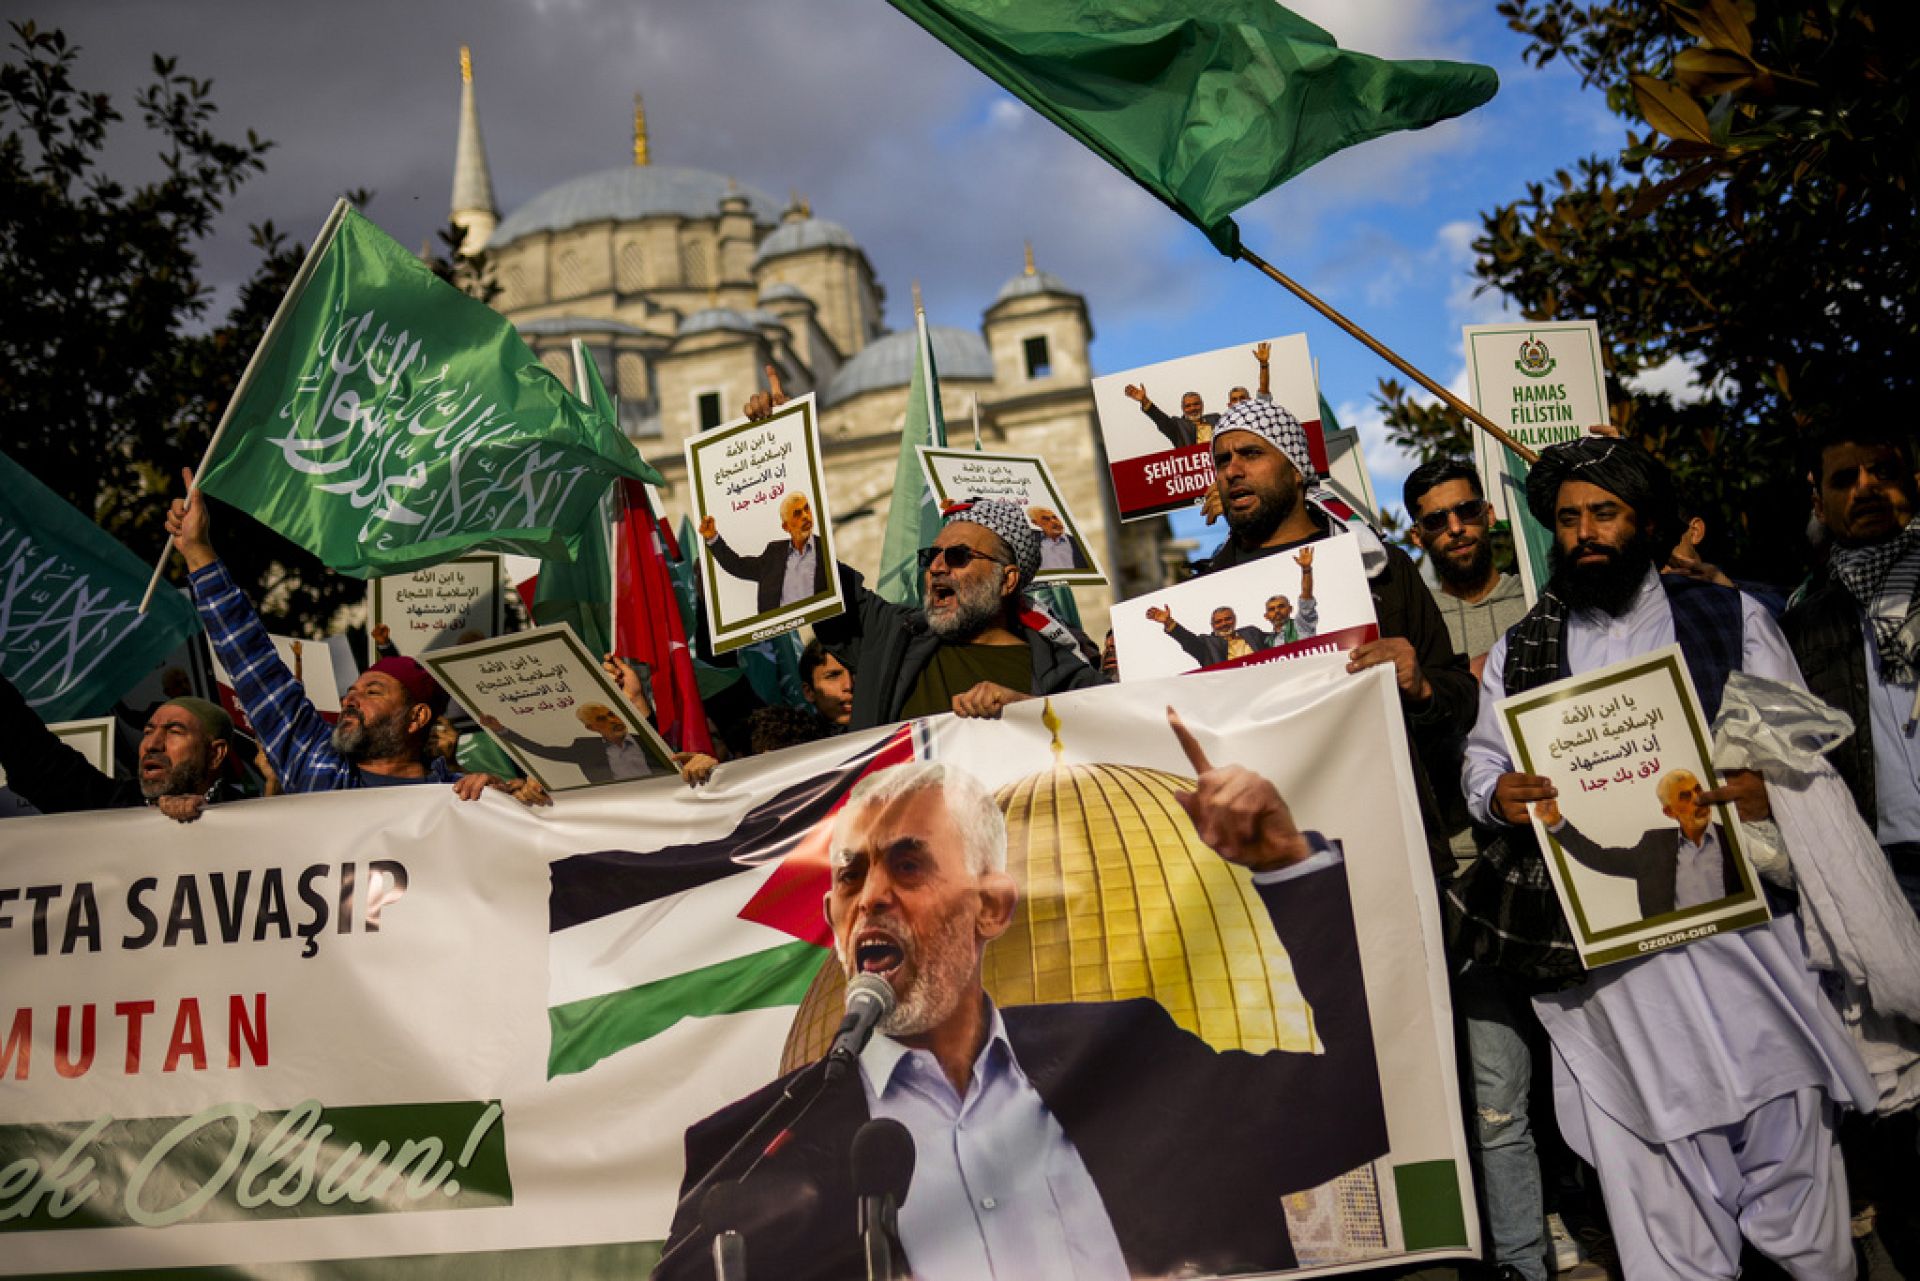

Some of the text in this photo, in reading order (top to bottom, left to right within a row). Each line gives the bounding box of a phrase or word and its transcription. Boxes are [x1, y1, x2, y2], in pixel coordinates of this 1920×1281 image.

[1512, 384, 1567, 403] HAMAS
[1510, 401, 1573, 424] FİLİSTİN
[767, 431, 775, 444] يا
[1508, 425, 1580, 445] HALKININ
[1143, 452, 1212, 484] ŞEHİTLER
[1165, 468, 1216, 496] SÜRDÜ
[1599, 698, 1620, 719] ابن
[1622, 694, 1637, 711] يا
[1549, 708, 1664, 758] الإسلامية الشجاع
[1642, 733, 1661, 752] إن
[1613, 767, 1633, 784] بك
[121, 860, 409, 958] SAVAŞIP
[0, 992, 269, 1080] MUTAN
[125, 1099, 502, 1227] Olsun!
